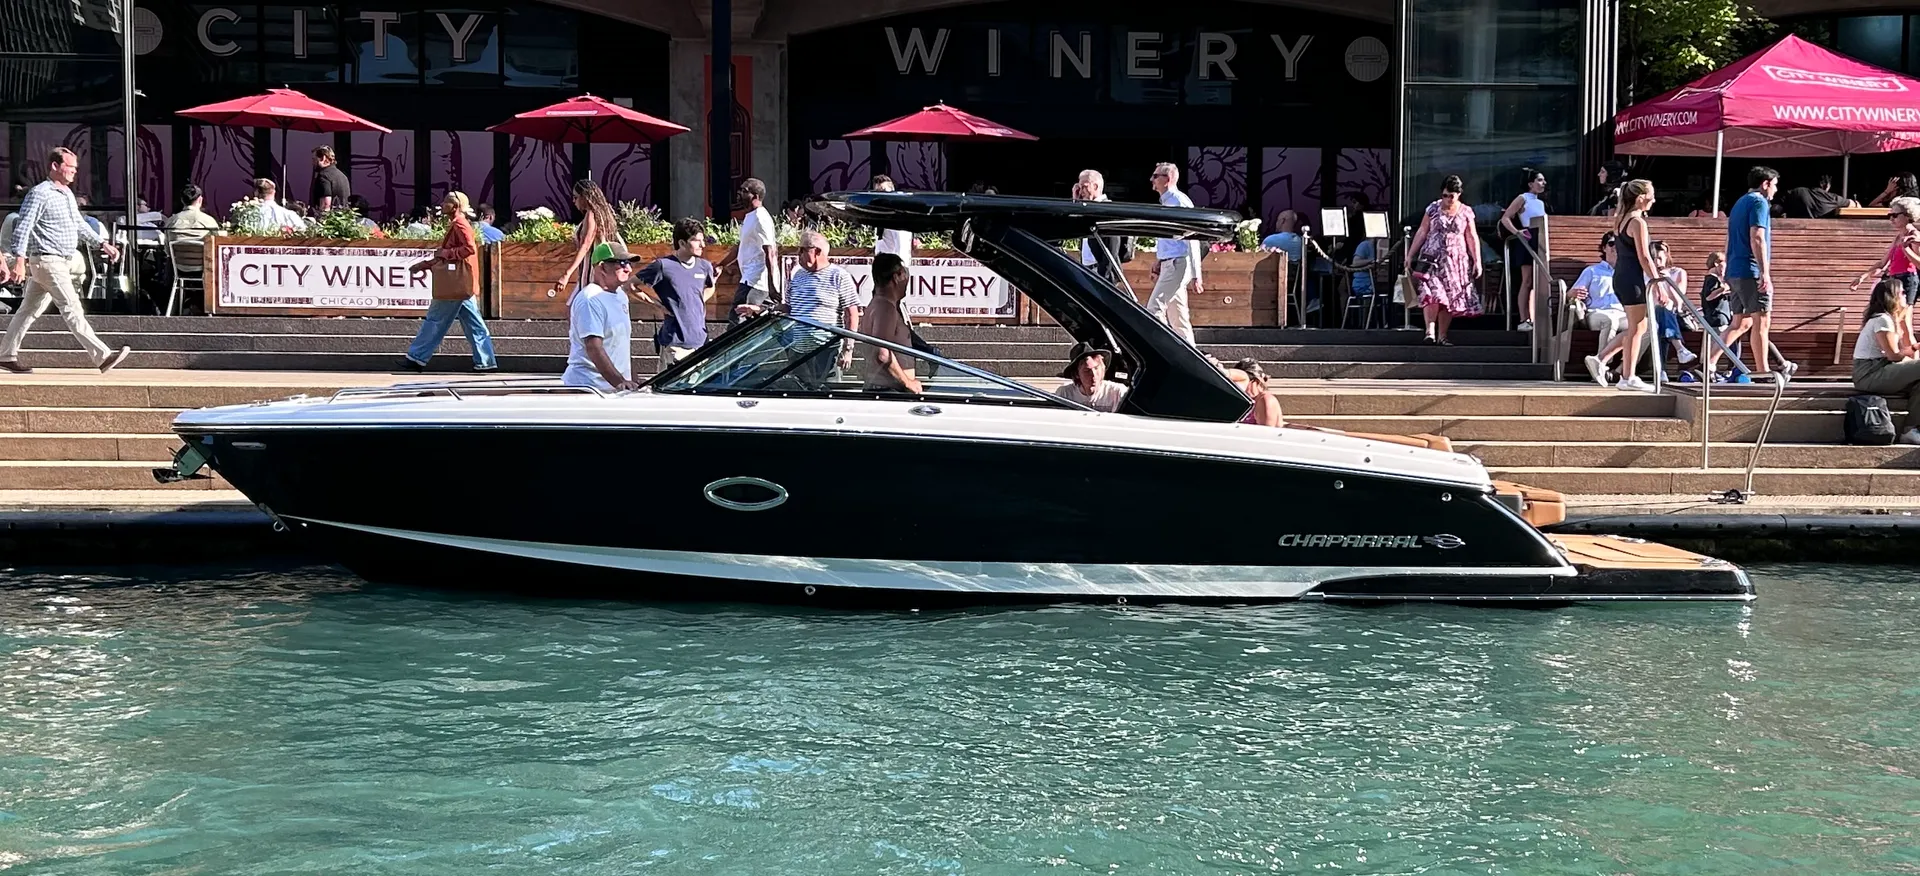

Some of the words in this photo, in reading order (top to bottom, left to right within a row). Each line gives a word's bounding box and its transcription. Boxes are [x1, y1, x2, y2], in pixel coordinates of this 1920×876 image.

[197, 7, 484, 62] CITY
[884, 26, 1315, 82] WINERY
[1775, 68, 1815, 80] CITY
[1819, 75, 1891, 89] WINERY
[239, 264, 312, 287] CITY
[321, 264, 429, 289] WINER
[909, 274, 996, 298] INERY
[320, 297, 373, 306] CHICAGO
[1278, 533, 1423, 548] CHAPARRAL
